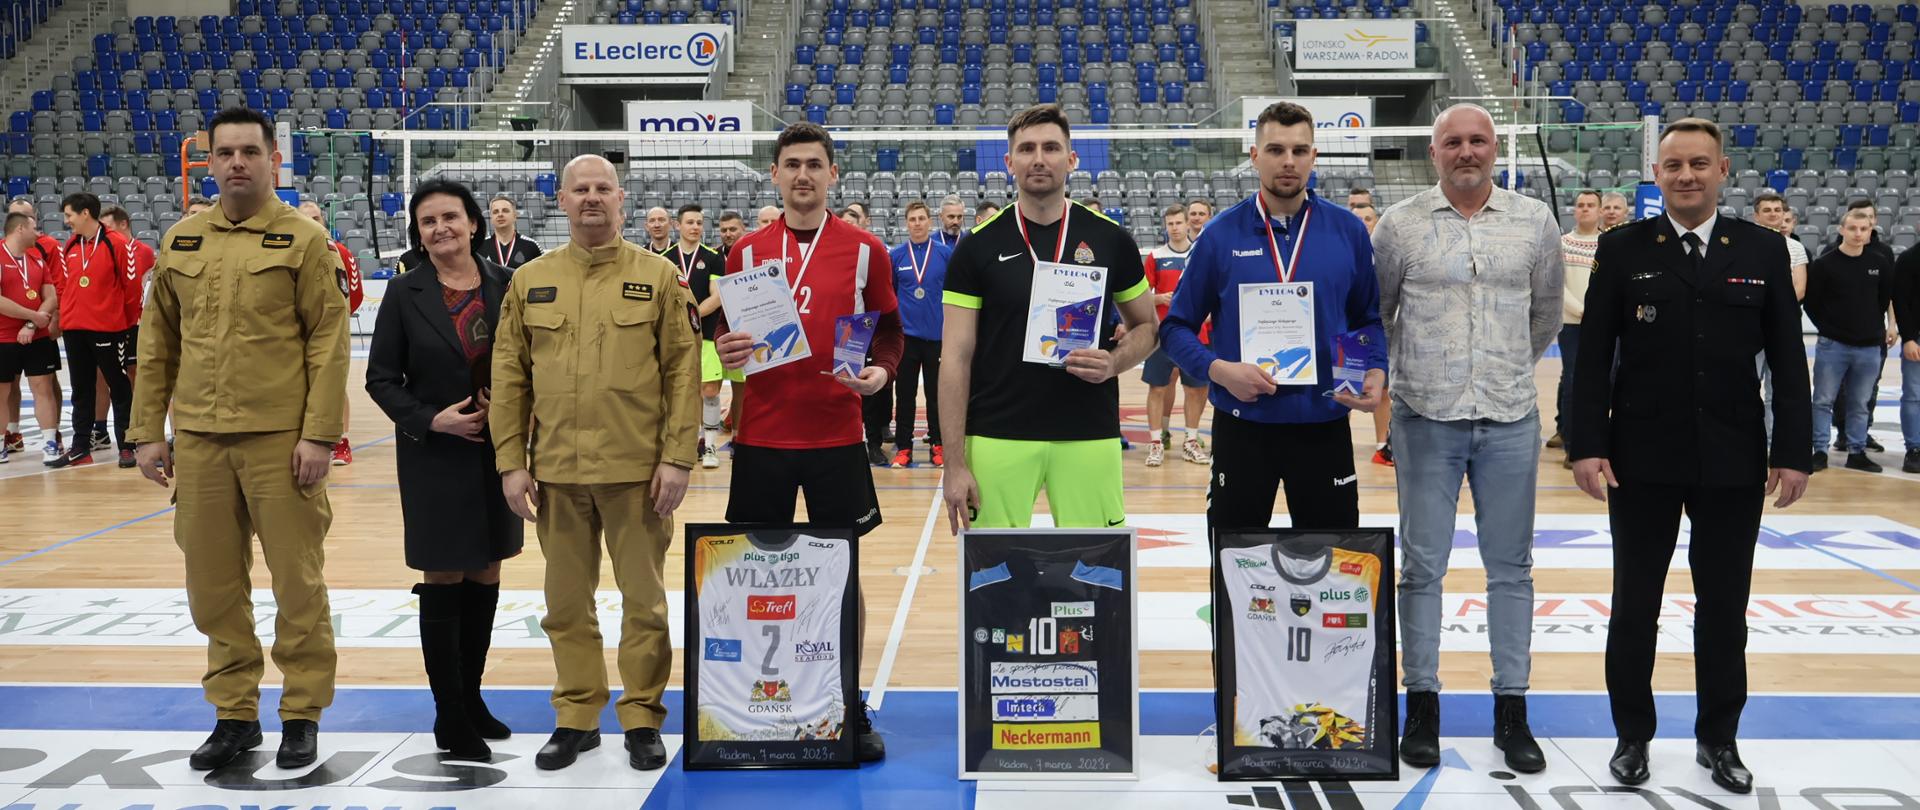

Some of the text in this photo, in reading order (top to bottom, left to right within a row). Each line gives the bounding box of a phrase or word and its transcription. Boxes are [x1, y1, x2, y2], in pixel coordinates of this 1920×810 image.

[575, 42, 682, 60] E.Leclerc
[1219, 473, 1225, 487] 8
[744, 551, 800, 563] plus liga
[725, 567, 821, 588] WLAZŁY
[1320, 588, 1351, 603] plus
[766, 601, 793, 615] Trefl
[1054, 605, 1083, 616] Plus
[1029, 617, 1057, 655] 10
[761, 625, 780, 675] 2
[795, 641, 834, 654] ROYAL
[1288, 626, 1312, 662] 10
[992, 675, 1088, 687] Mostostal
[748, 703, 792, 713] GDAŃSK
[1006, 701, 1045, 712] Imtech
[1001, 729, 1091, 745] Neckermann
